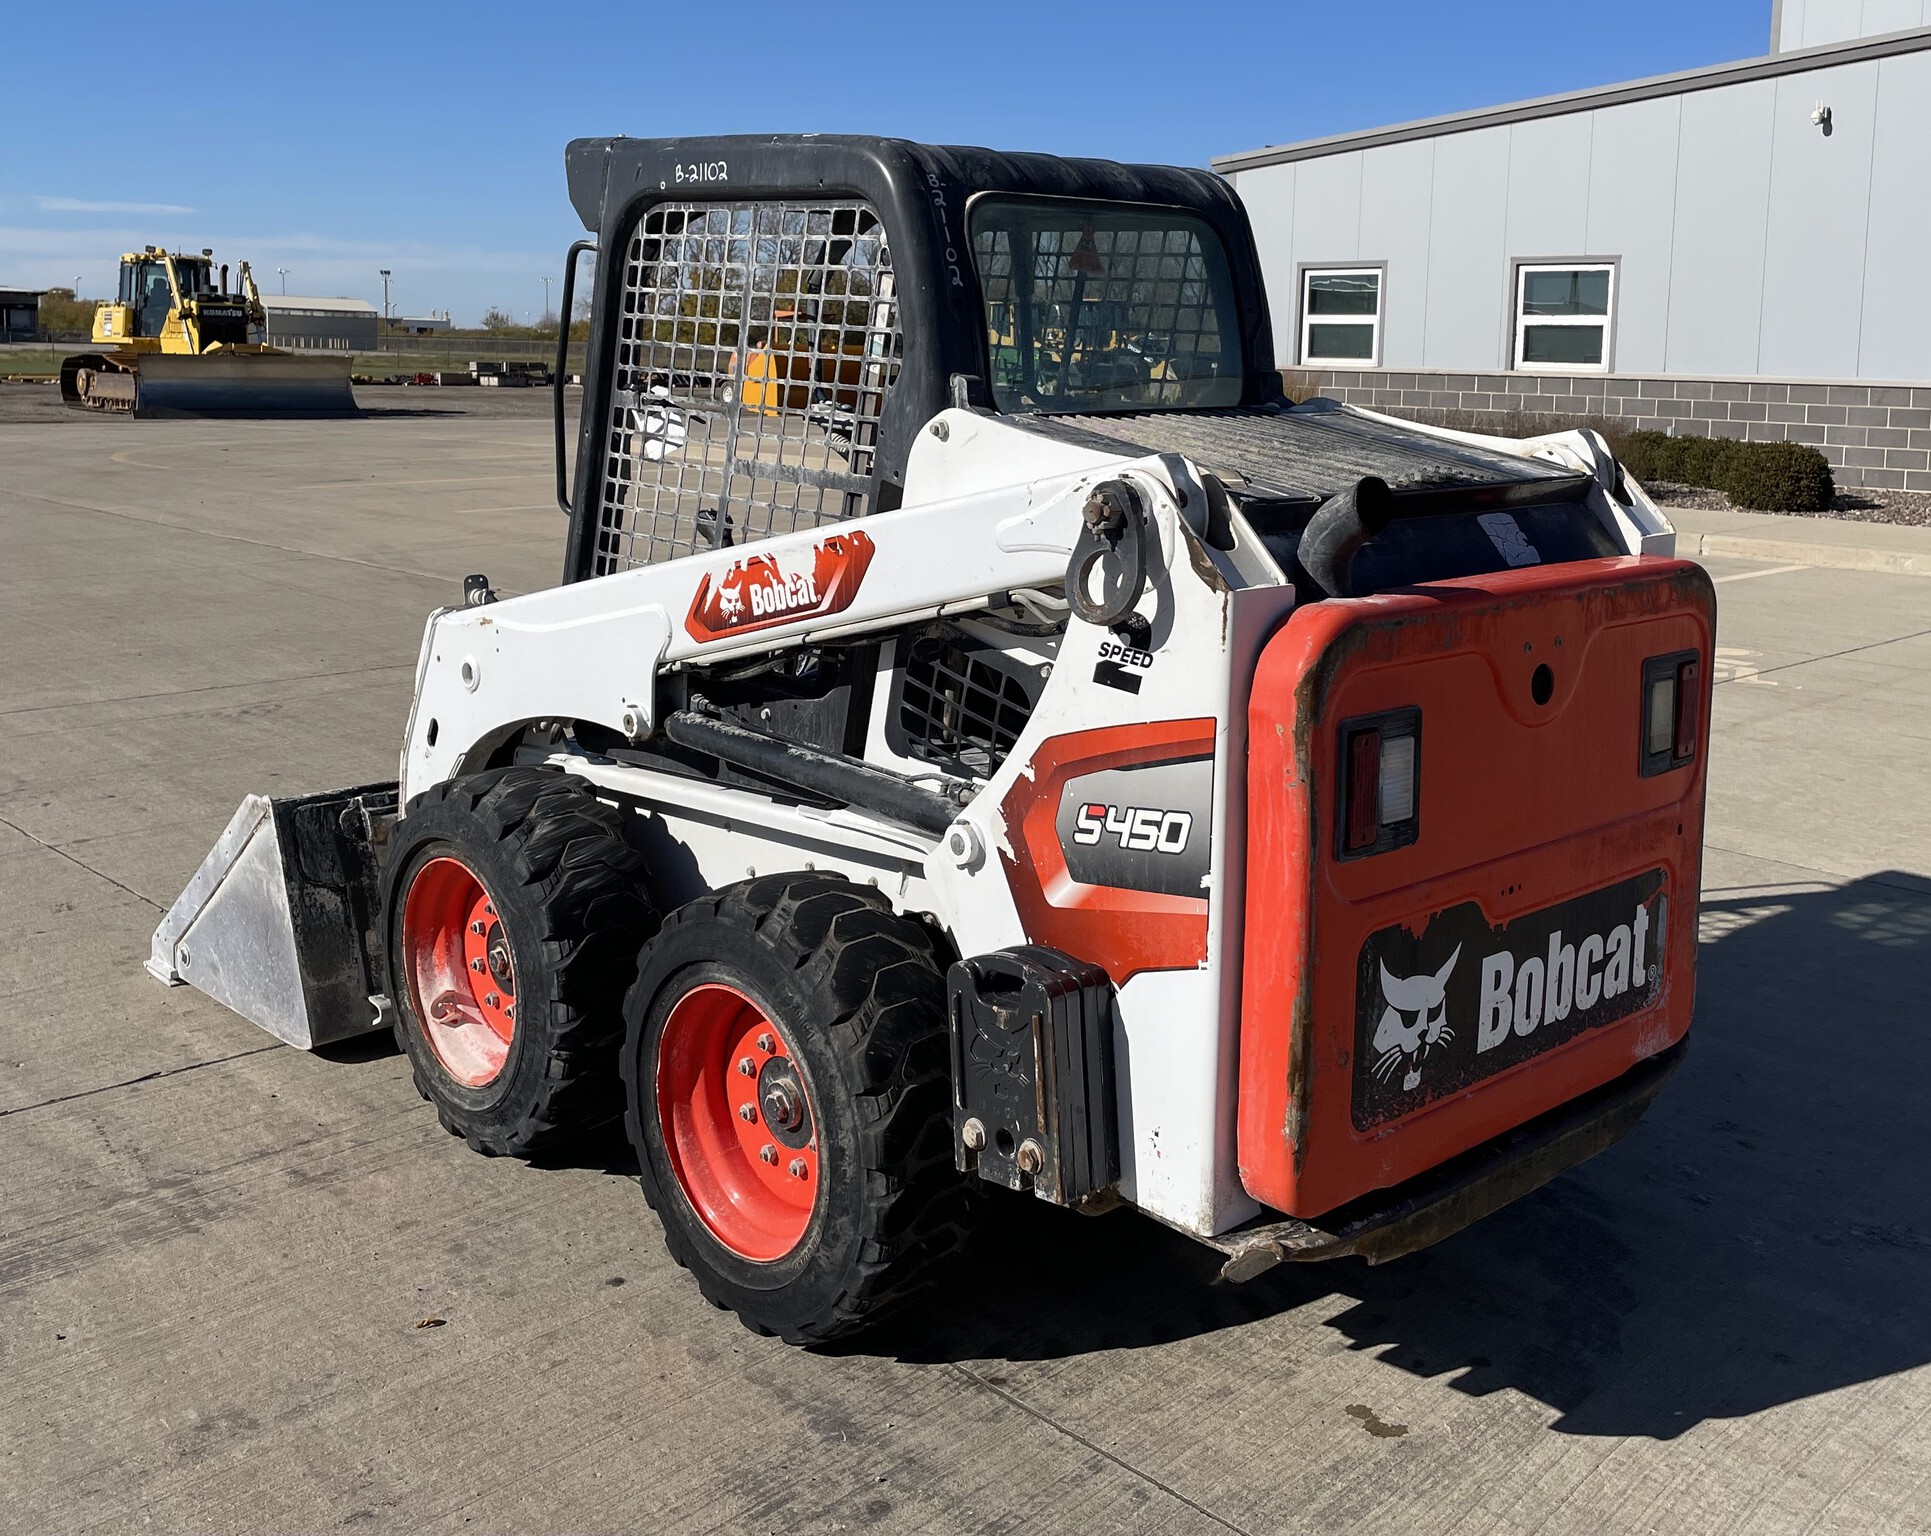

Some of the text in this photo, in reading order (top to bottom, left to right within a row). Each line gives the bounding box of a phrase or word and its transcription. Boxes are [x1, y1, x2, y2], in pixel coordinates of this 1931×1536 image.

[675, 161, 728, 183] B-21102
[927, 173, 964, 287] B-21102
[203, 308, 243, 317] KOMATSU
[749, 572, 818, 616] Bobcat
[1097, 641, 1154, 669] SPEED
[1072, 802, 1194, 856] S450
[1476, 903, 1650, 1055] Bobcat
